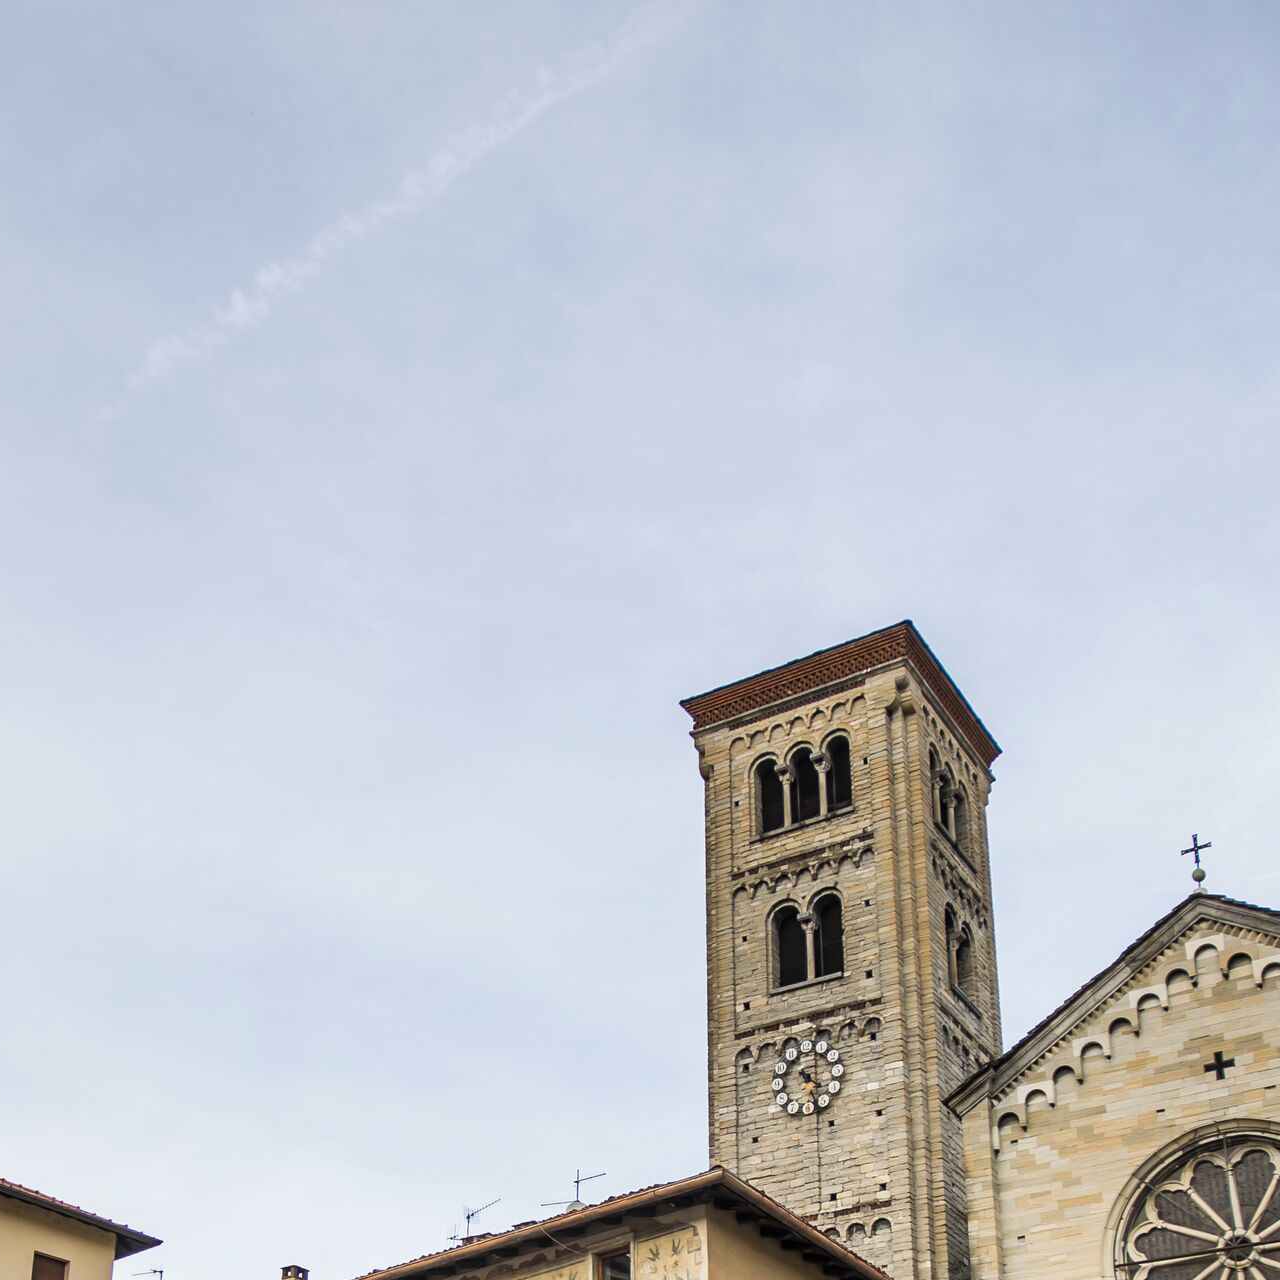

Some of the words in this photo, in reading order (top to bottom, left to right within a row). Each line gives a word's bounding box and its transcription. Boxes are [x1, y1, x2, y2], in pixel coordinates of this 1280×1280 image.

[802, 1042, 811, 1051] 12
[788, 1050, 795, 1060] 11
[829, 1051, 837, 1060] 2
[777, 1063, 786, 1073] 10
[835, 1065, 841, 1075] 3
[774, 1080, 780, 1089] 9
[779, 1094, 785, 1103] 8
[821, 1096, 827, 1105] 5
[790, 1103, 796, 1113] 7
[805, 1103, 811, 1113] 6
